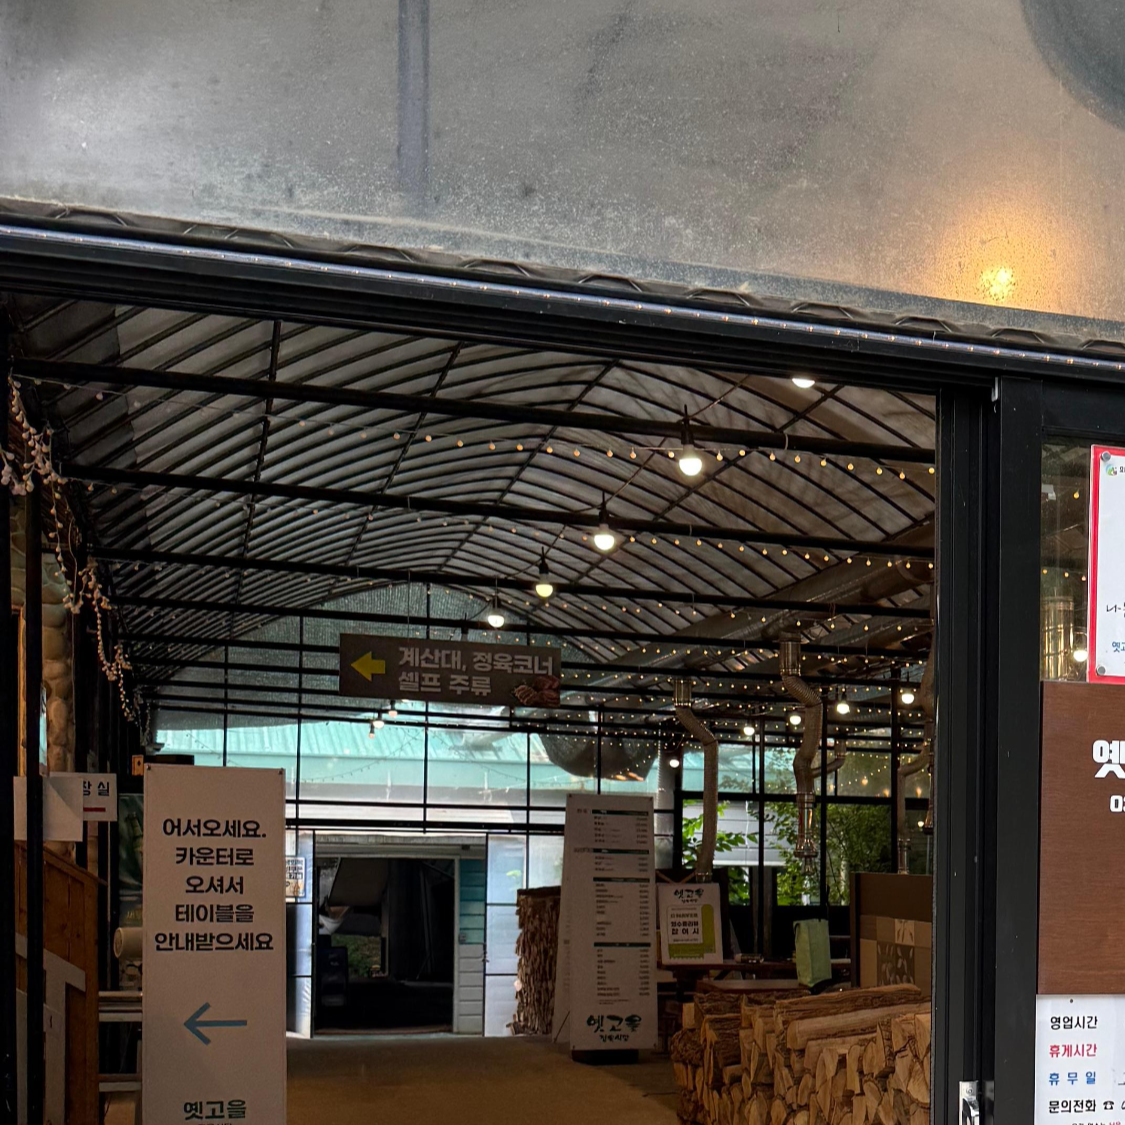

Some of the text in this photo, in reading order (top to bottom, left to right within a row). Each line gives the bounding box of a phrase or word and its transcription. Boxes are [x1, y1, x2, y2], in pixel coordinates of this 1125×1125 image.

[398, 647, 553, 675] 계산대, 정육코너
[398, 672, 492, 696] 셀프 주류
[162, 818, 267, 838] 어서오세요.
[175, 847, 254, 866] 카운터로
[185, 876, 244, 894] 오셔서
[175, 904, 254, 923] 테이블을
[154, 932, 274, 951] 안내받으세요
[1050, 1015, 1098, 1030] 영업시간
[1049, 1044, 1098, 1058] 휴게시간
[183, 1099, 247, 1120] 옛고을
[1048, 1099, 1097, 1113] 문의전화
